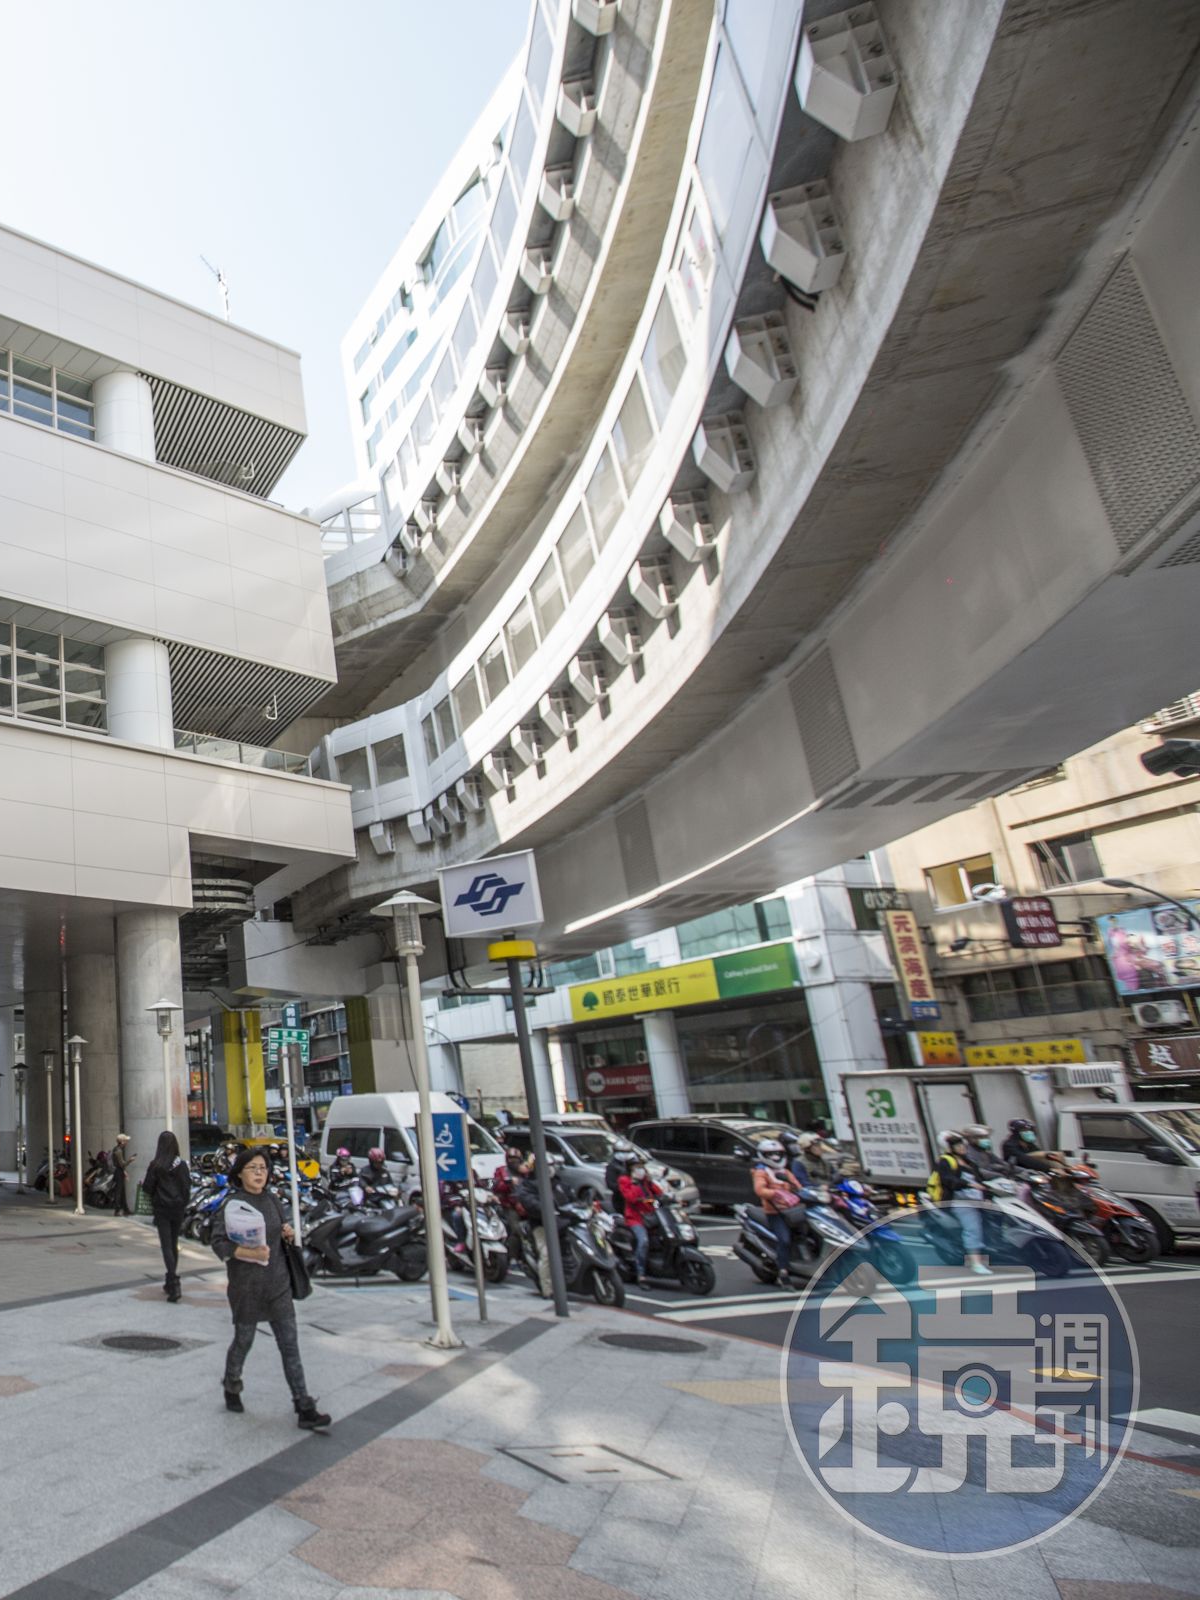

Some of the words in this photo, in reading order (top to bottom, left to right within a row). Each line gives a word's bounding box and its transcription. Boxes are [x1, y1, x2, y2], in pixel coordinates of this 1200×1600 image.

[603, 977, 680, 1006] 國泰世華銀行
